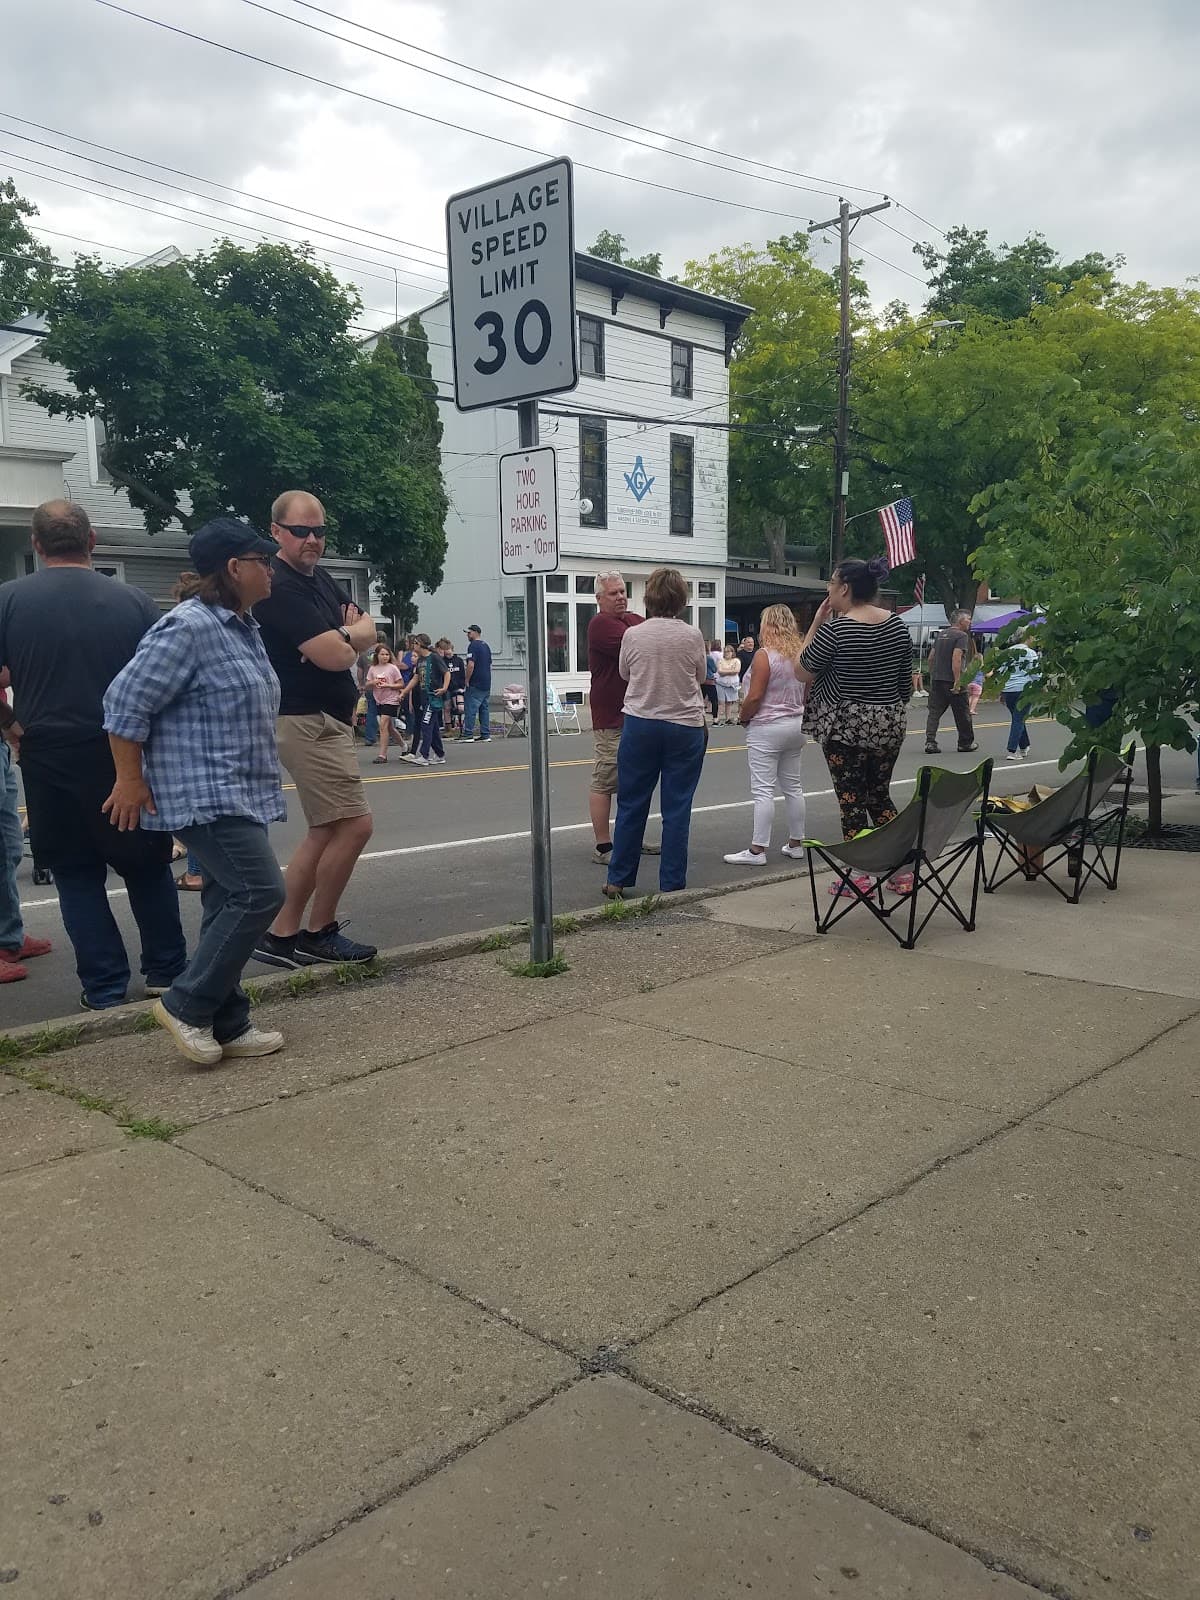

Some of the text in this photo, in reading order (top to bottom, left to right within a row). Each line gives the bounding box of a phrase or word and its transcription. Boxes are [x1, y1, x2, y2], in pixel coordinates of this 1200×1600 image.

[458, 179, 559, 234] VILLAGE
[471, 221, 547, 266] SPEED
[480, 259, 539, 299] LIMIT
[474, 299, 552, 376] 30
[516, 468, 536, 487] TWO
[633, 472, 644, 490] G
[516, 492, 541, 510] HOUR
[510, 514, 547, 534] PARKING
[504, 540, 522, 557] 8am
[533, 537, 555, 557] 10pm
